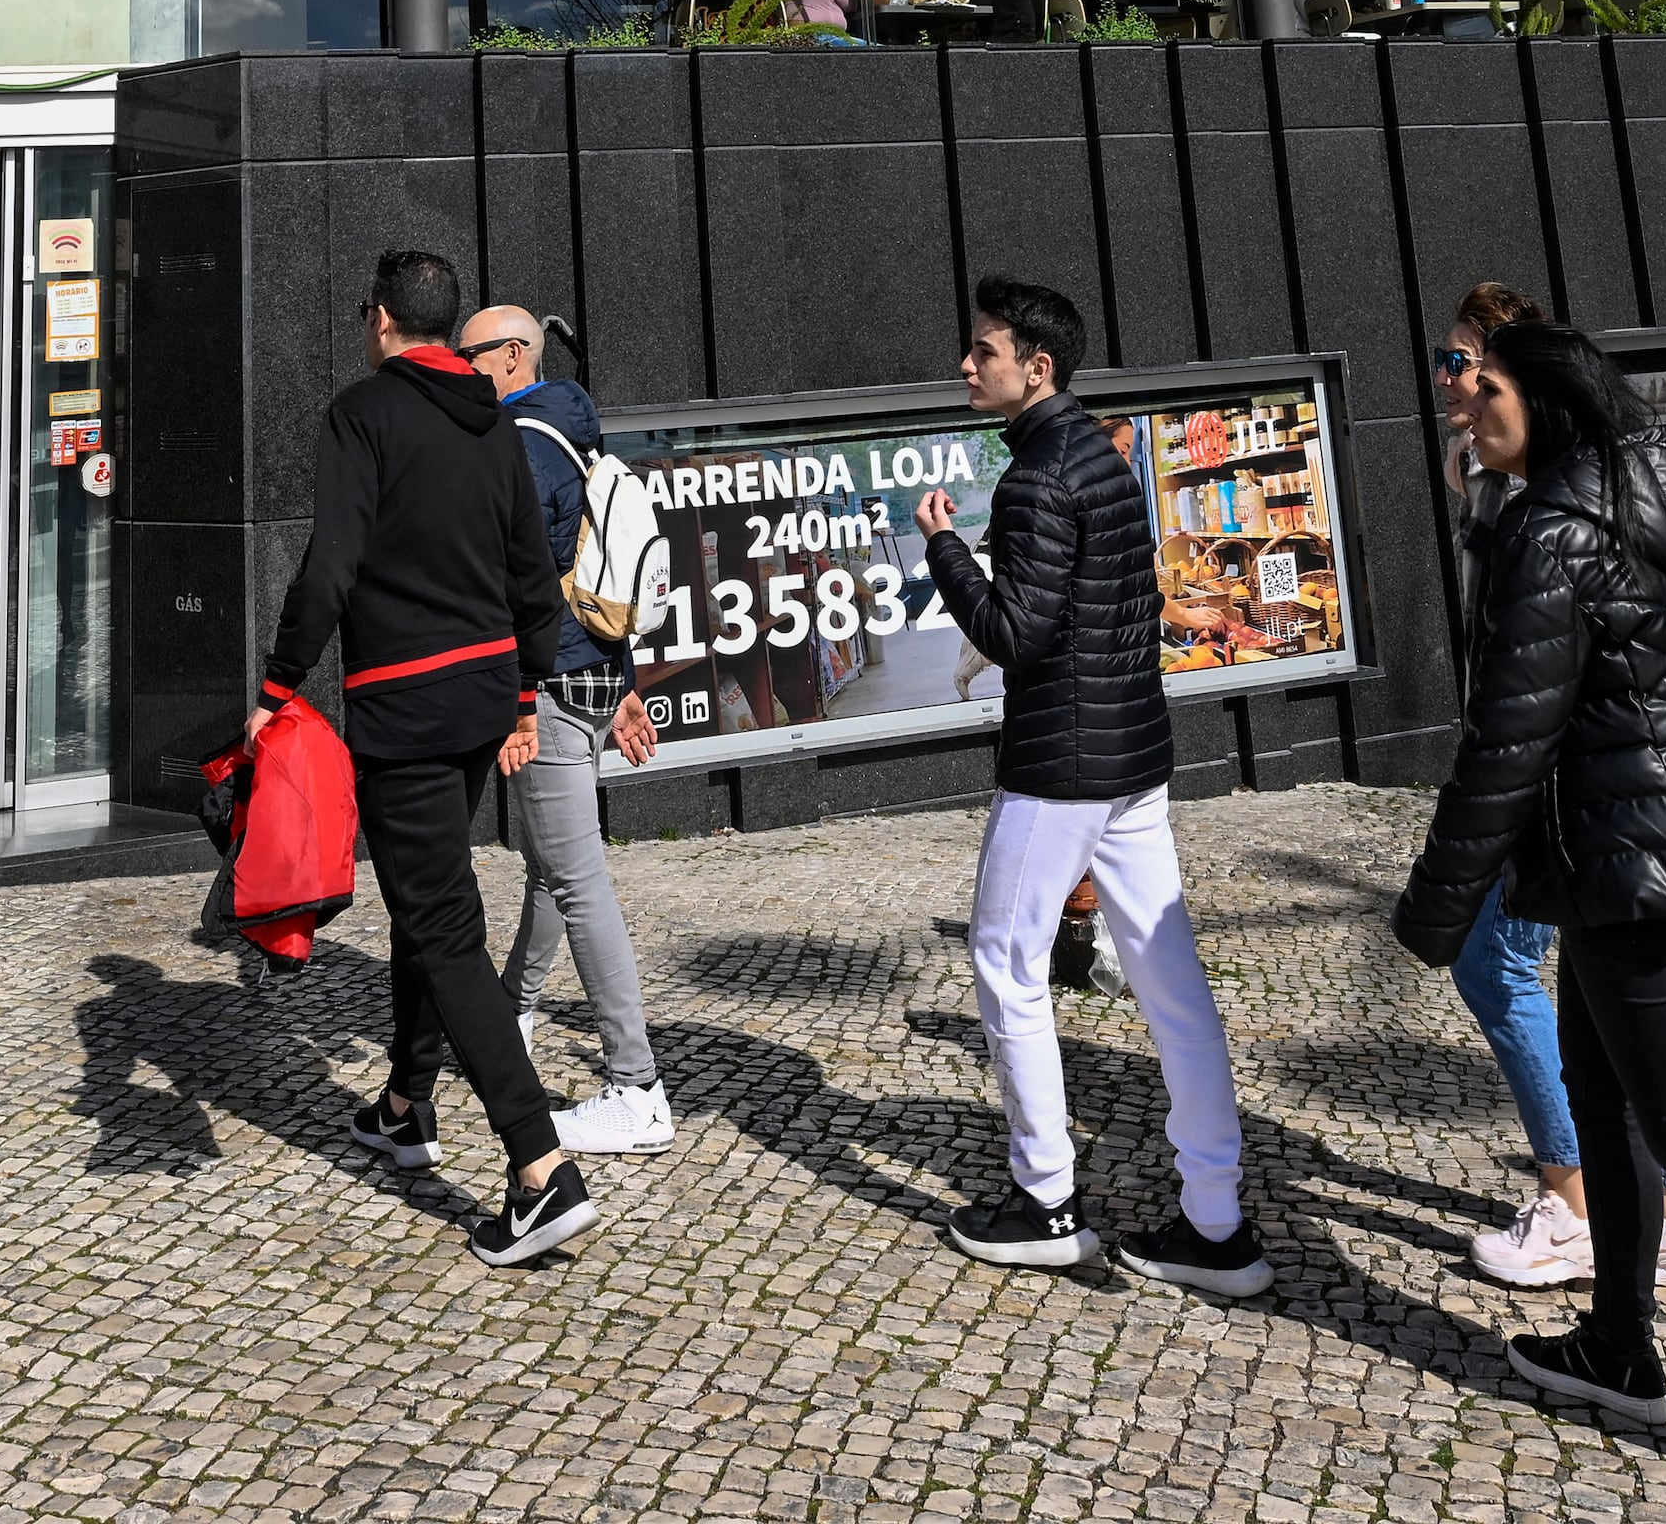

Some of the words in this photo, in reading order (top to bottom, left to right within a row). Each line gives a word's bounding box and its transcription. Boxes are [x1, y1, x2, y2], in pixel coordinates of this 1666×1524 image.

[1231, 419, 1286, 456] JLL
[643, 453, 855, 512] ARRENDA
[870, 443, 974, 491] LOJA
[175, 592, 202, 613] GÁS
[629, 553, 993, 666] 135832
